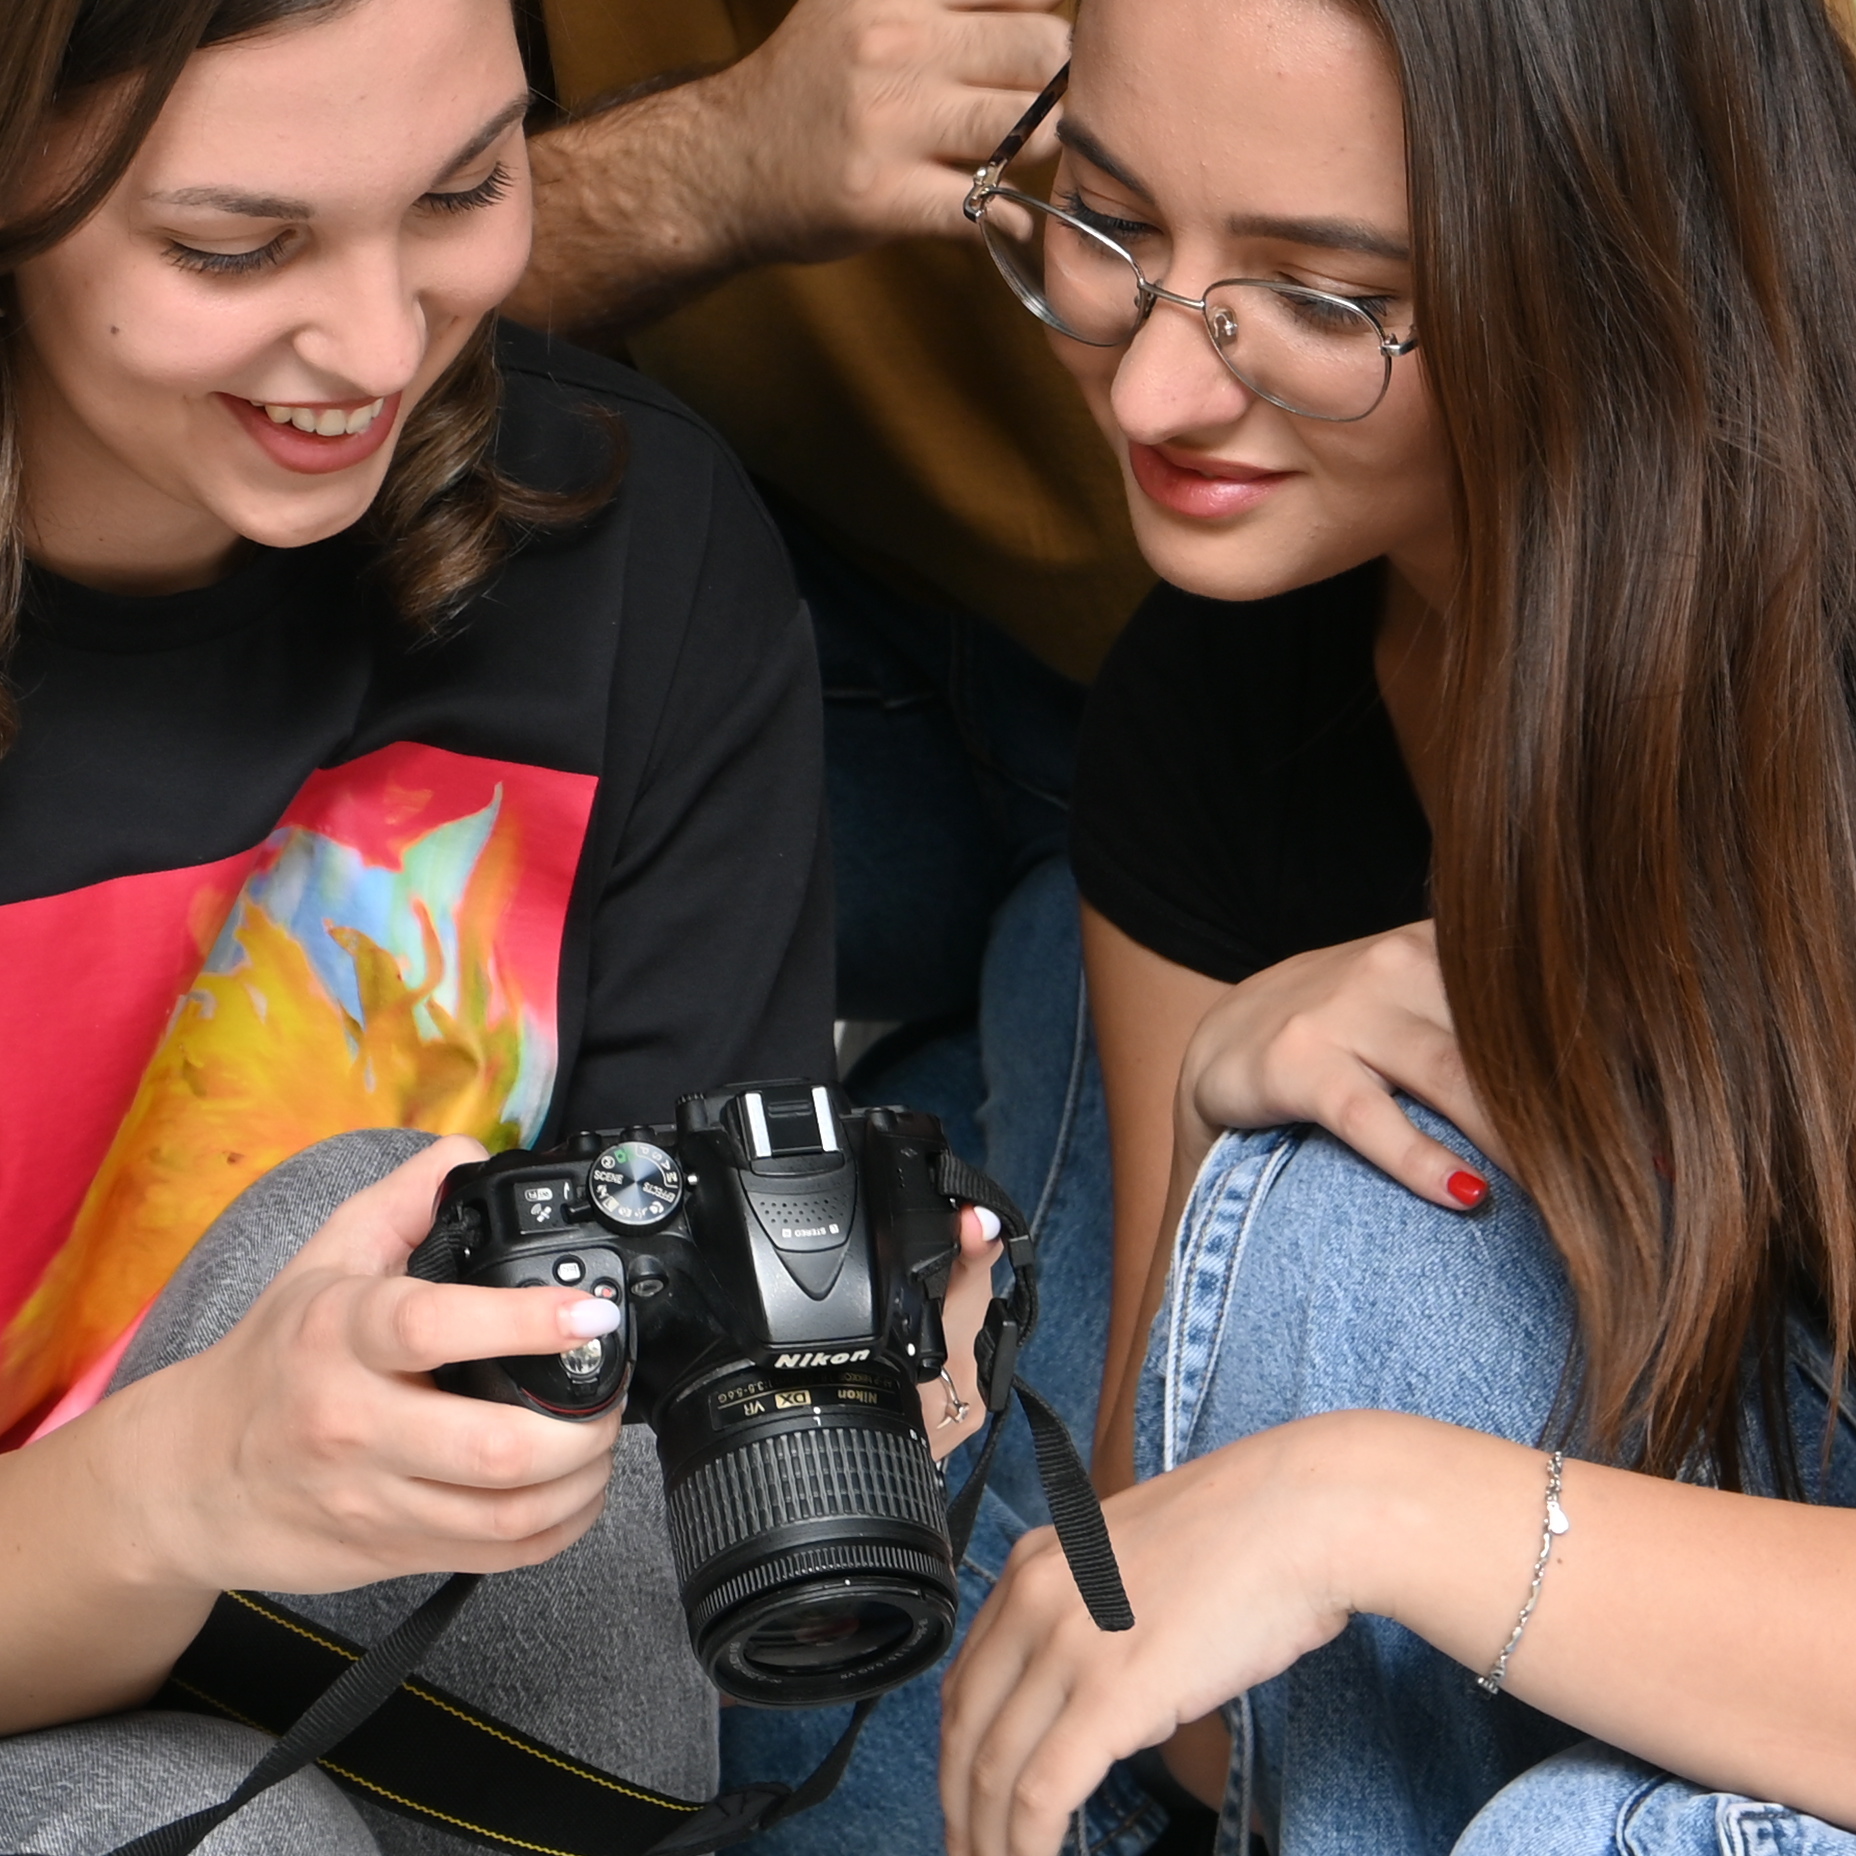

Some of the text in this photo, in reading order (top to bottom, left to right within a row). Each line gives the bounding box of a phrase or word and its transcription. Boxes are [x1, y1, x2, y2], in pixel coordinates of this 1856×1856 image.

[594, 1170, 624, 1185] SCENE
[642, 1182, 676, 1204] EFFECTS
[774, 1349, 871, 1369] Nikon
[744, 1389, 878, 1417] Nikon DX VR
